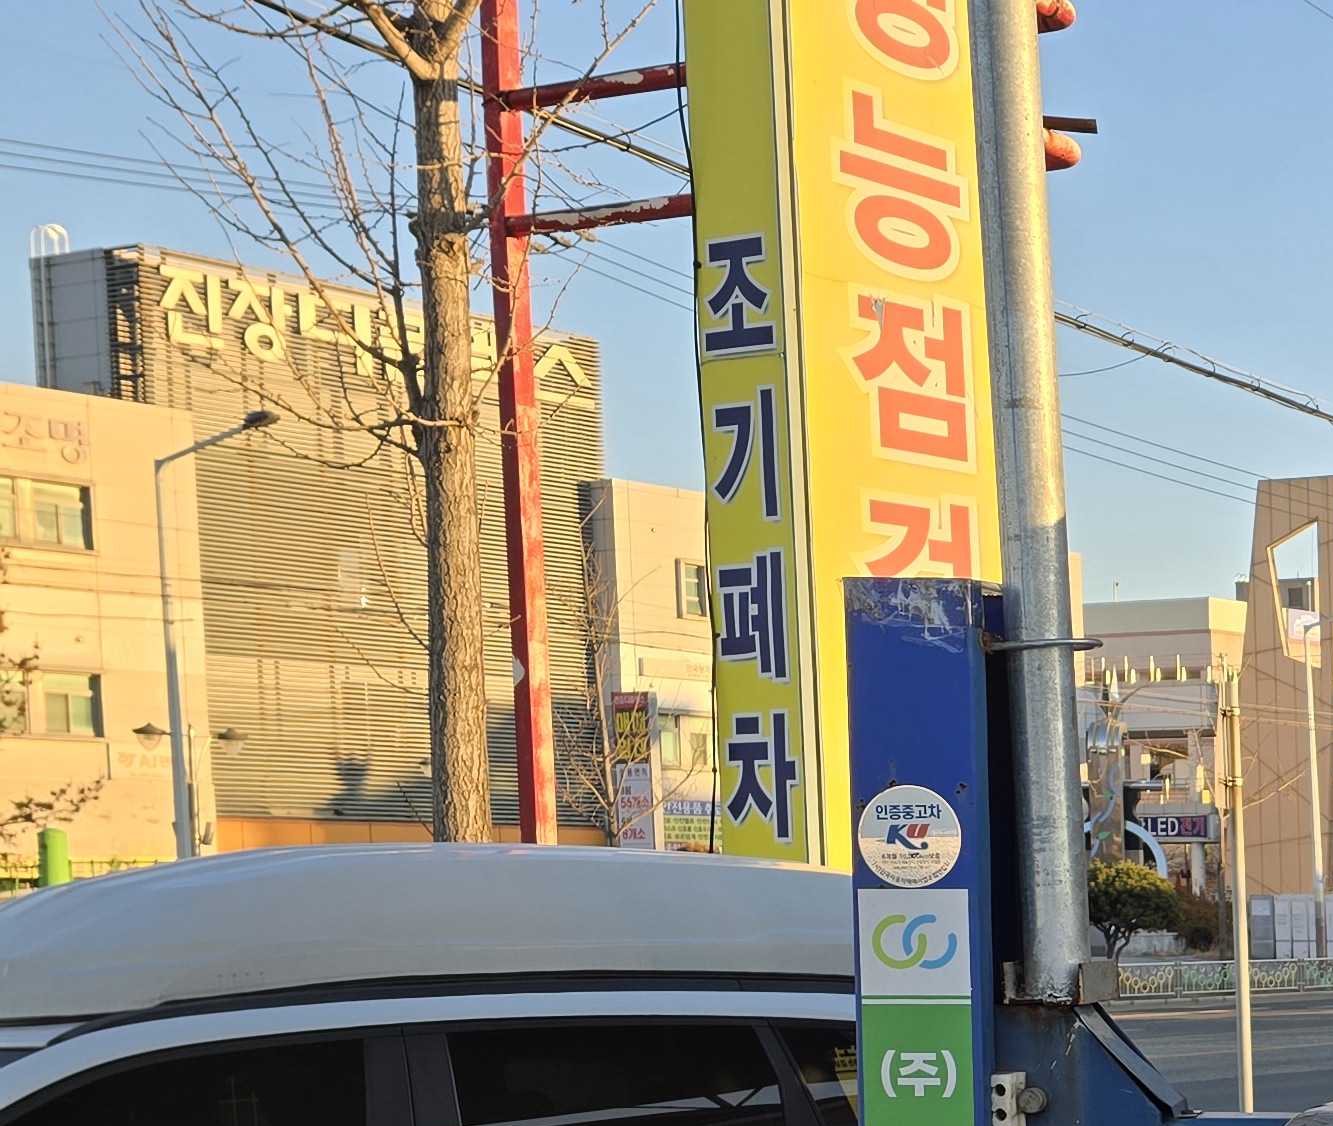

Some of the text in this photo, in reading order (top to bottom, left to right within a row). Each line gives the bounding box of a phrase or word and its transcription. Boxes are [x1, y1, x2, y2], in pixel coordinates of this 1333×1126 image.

[706, 236, 796, 839] 조기폐차
[840, 0, 971, 578] 능점
[875, 804, 941, 820] 인증중고차
